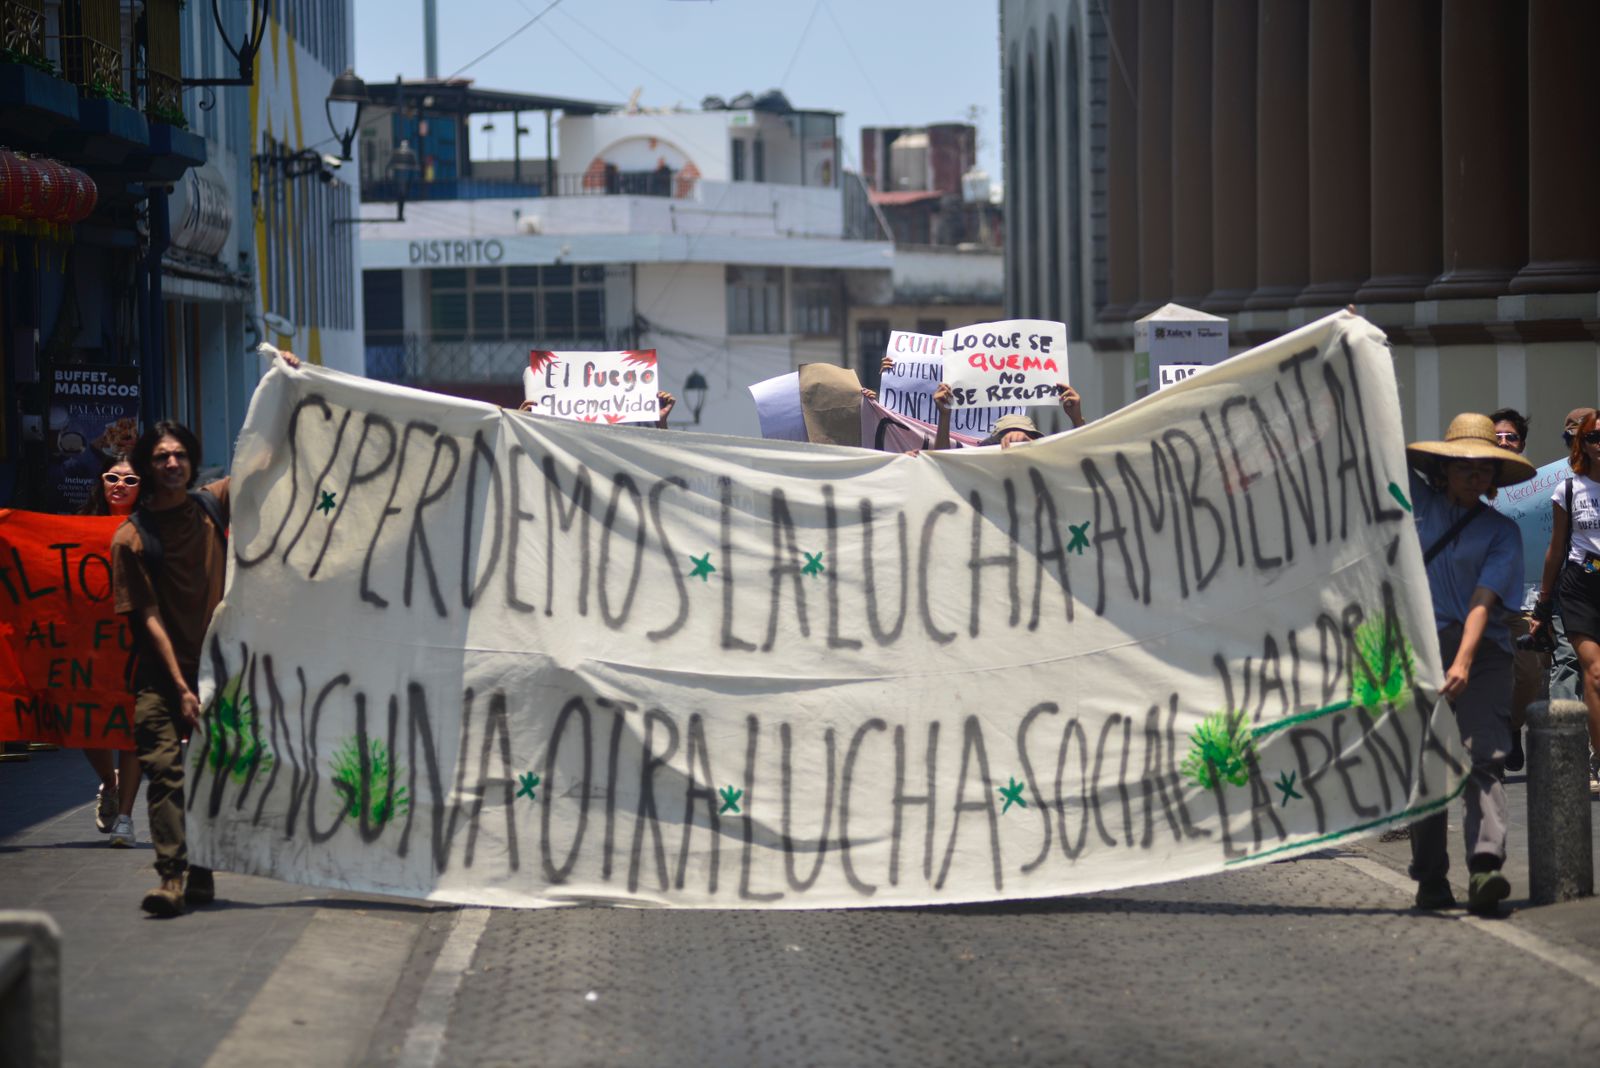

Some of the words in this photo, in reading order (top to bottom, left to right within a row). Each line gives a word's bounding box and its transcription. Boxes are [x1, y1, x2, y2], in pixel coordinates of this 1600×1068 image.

[409, 240, 504, 263] DISTRITO
[953, 333, 977, 352] LO
[983, 332, 1021, 348] QUE
[1028, 334, 1053, 353] SE
[968, 353, 1058, 373] QUEMA
[54, 370, 108, 382] BUFFET
[545, 361, 569, 388] El
[584, 361, 654, 391] fuego
[1000, 372, 1026, 384] NO
[55, 382, 139, 397] MARISCOS
[951, 387, 977, 405] SE
[234, 393, 352, 567] SI
[307, 407, 690, 643] PERDEMOS
[719, 475, 811, 653] LA
[821, 465, 1075, 651] LUCHA
[25, 619, 67, 649] AL
[48, 657, 94, 689] EN
[1207, 740, 1286, 858] LA
[1289, 683, 1464, 834] PENA
[540, 695, 721, 895] OTRA
[739, 712, 1003, 900] LUCHA
[1016, 692, 1211, 873] SOCIAL
